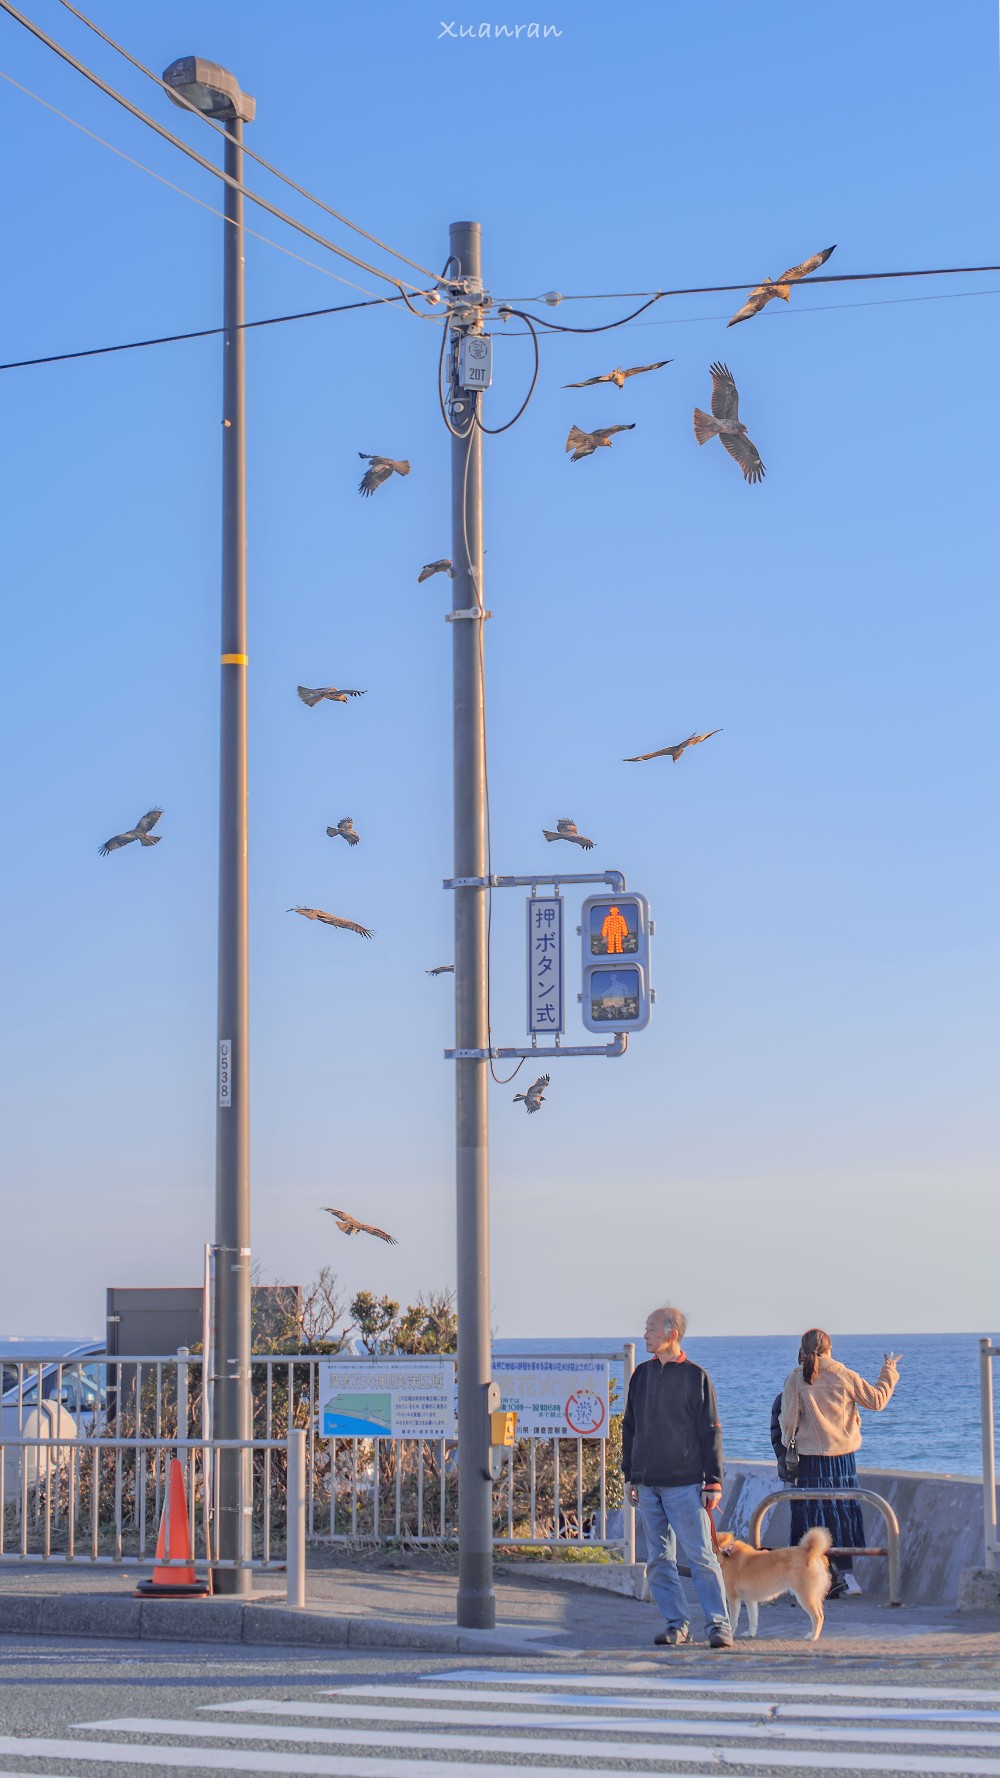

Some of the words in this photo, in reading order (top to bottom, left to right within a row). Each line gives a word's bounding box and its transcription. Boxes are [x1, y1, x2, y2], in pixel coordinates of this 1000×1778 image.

[469, 367, 486, 382] 20T
[535, 908, 556, 1023] 押ボタン式
[221, 1044, 229, 1097] 0538
